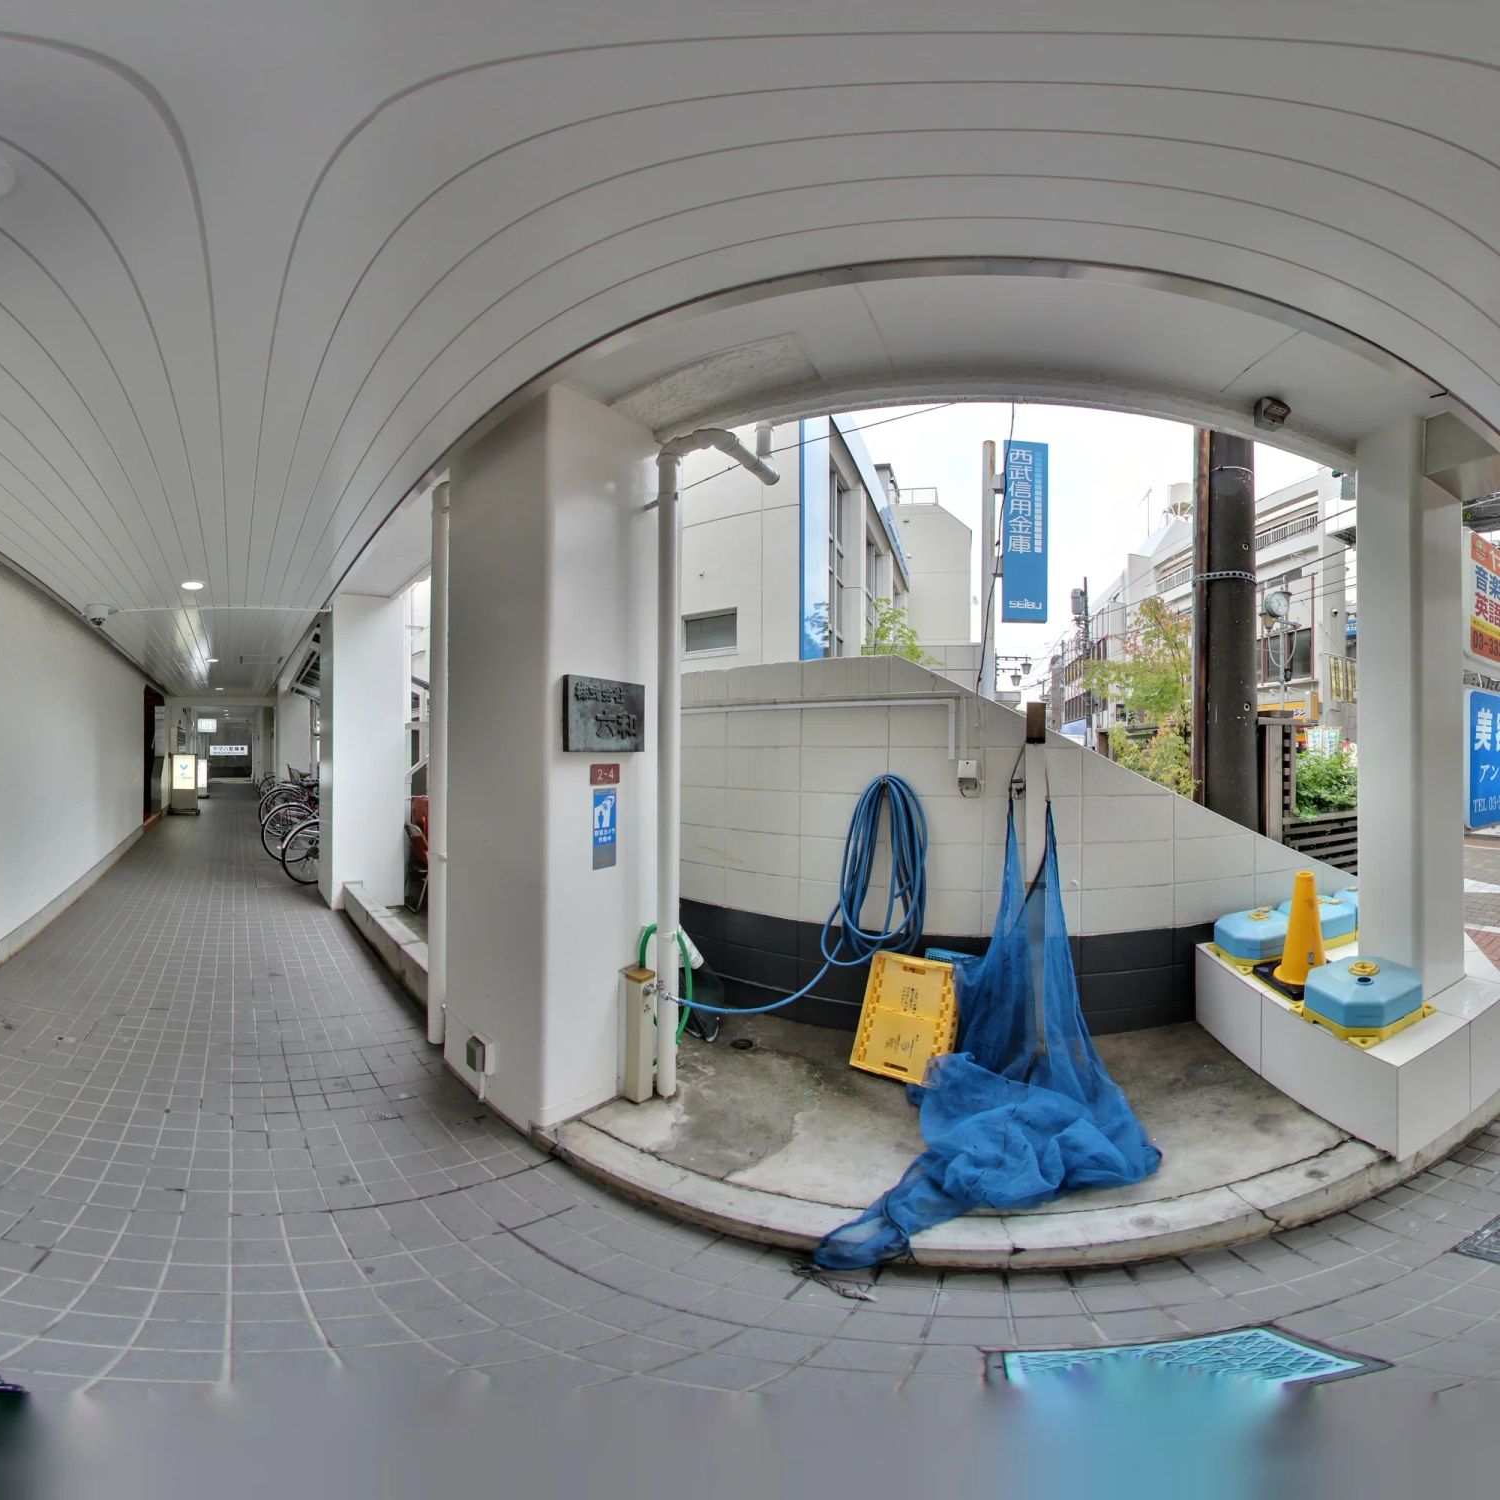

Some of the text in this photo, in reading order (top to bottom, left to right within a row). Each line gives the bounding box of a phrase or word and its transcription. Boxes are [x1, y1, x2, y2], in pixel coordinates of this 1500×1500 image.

[1008, 448, 1032, 554] 西武信用金庫
[1475, 708, 1500, 751] 美
[597, 768, 614, 780] 2-4
[1473, 798, 1487, 813] TEL
